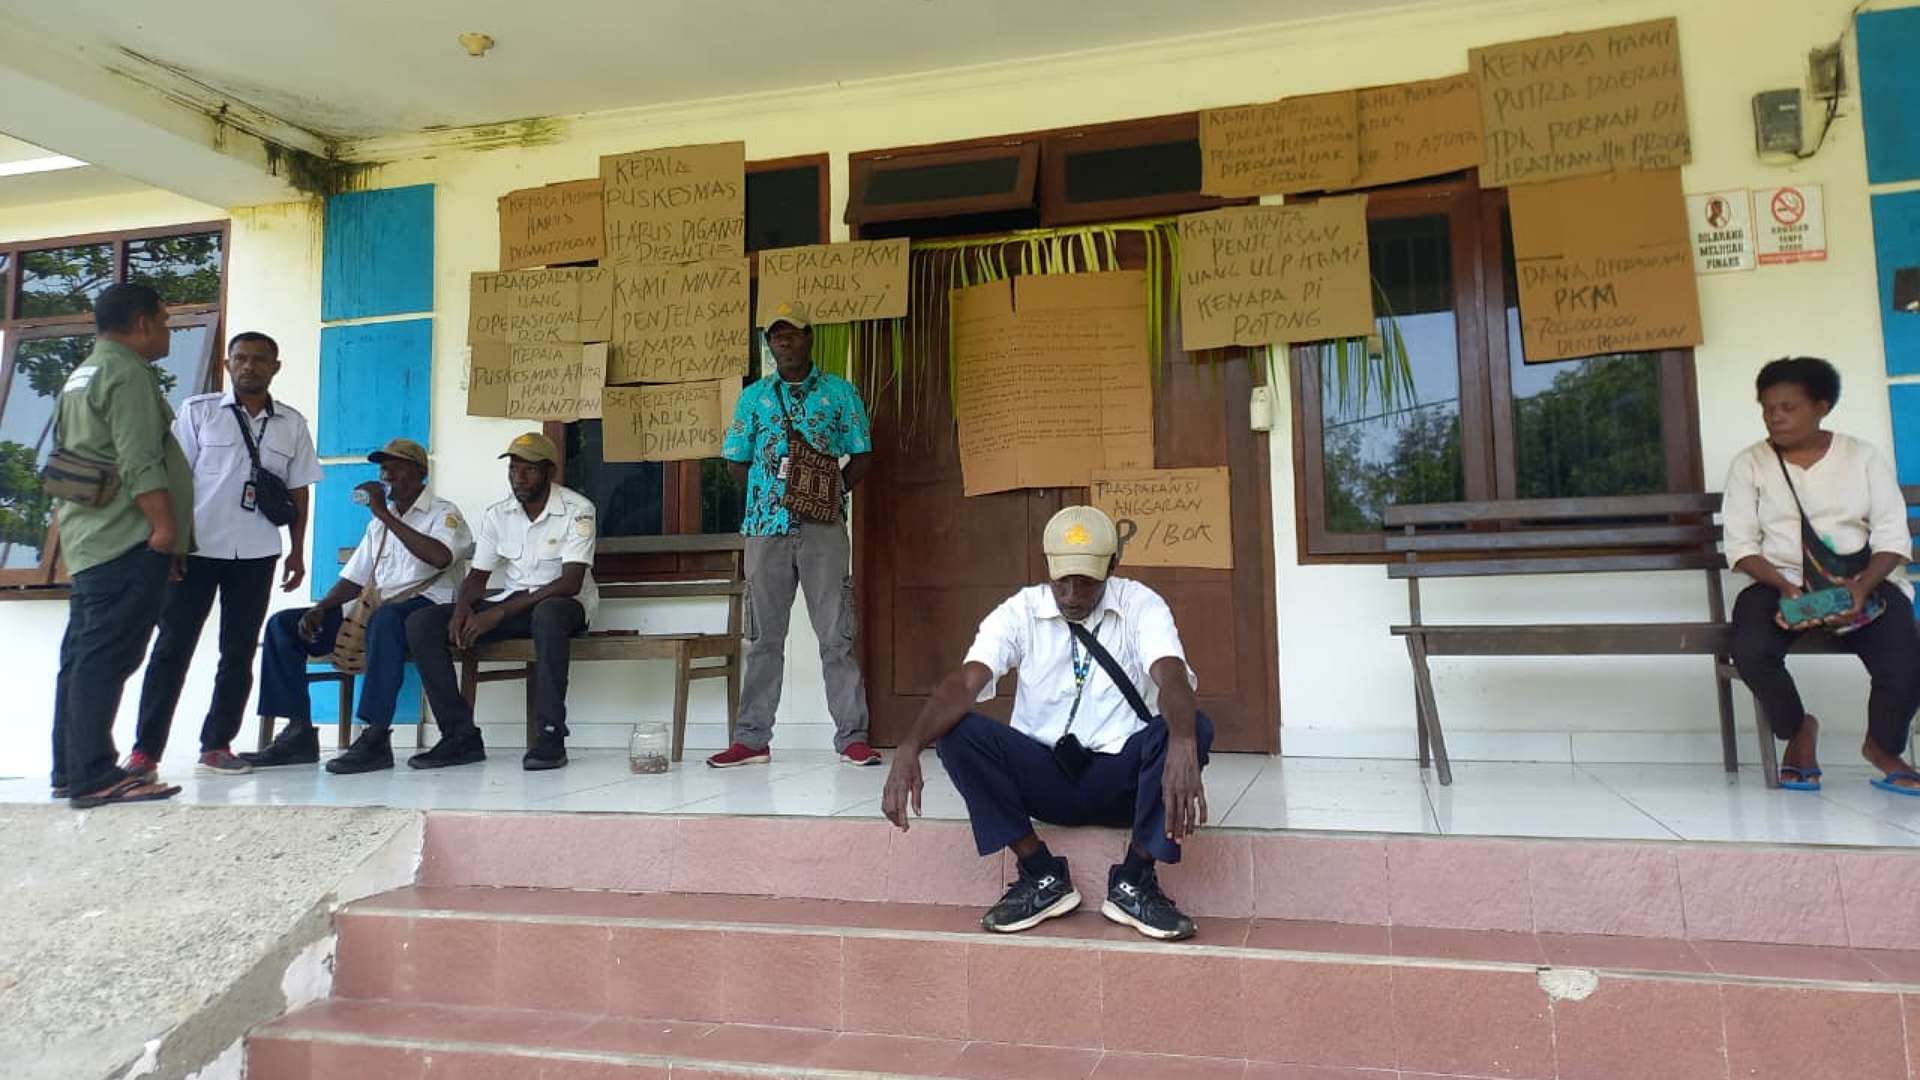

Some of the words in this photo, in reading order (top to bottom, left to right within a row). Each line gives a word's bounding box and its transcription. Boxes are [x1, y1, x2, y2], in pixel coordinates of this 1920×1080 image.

[616, 158, 692, 184] KEPALA
[606, 181, 736, 210] PUSKESMAS
[764, 248, 842, 276] KEPALA
[852, 241, 900, 271] PKM
[1250, 253, 1293, 277] ULP
[796, 272, 861, 299] HARUS
[1554, 282, 1618, 314] PKM
[1234, 308, 1321, 342] POTONG
[784, 494, 831, 521] PAPUA
